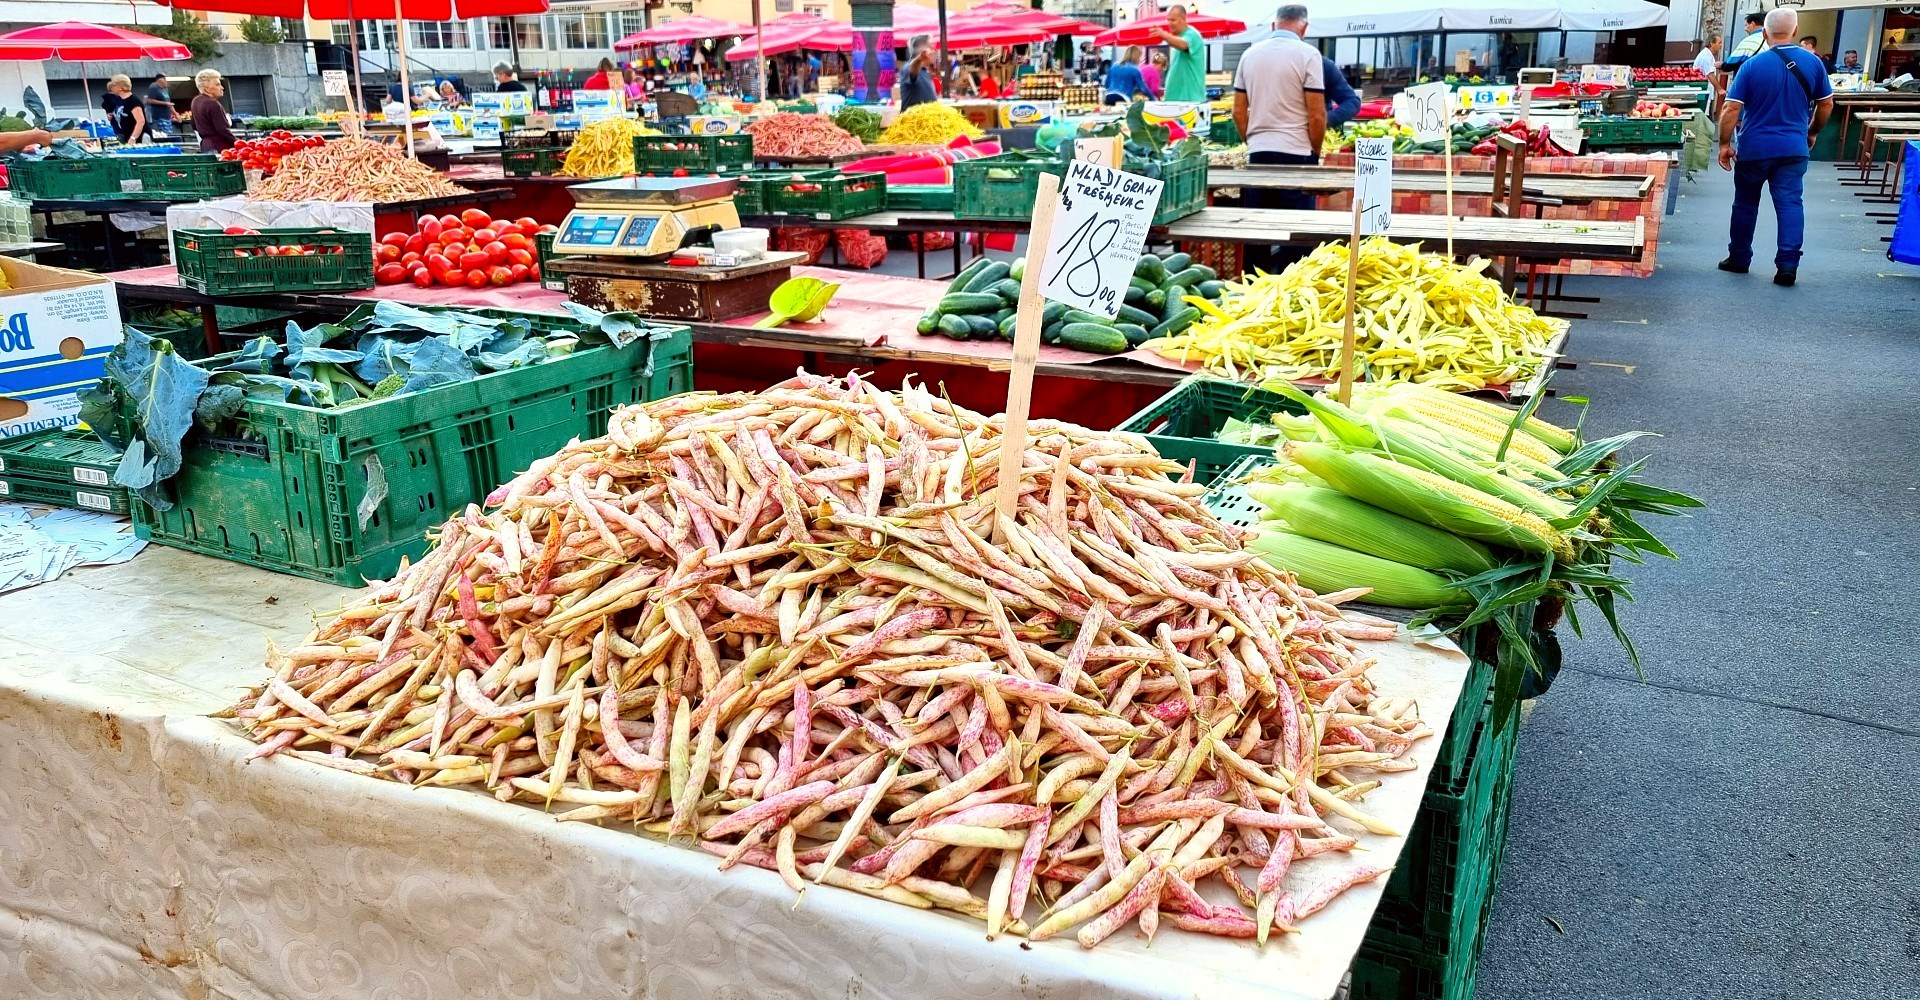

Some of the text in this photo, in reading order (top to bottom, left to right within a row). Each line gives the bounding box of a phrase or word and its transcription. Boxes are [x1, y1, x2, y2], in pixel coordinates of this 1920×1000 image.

[1489, 15, 1513, 25] Kumica
[1602, 18, 1624, 27] Kumica
[1346, 22, 1376, 31] Kumica
[707, 121, 727, 133] derby
[1071, 163, 1158, 196] MLADI GRAH
[0, 413, 78, 438] PREMIUM
